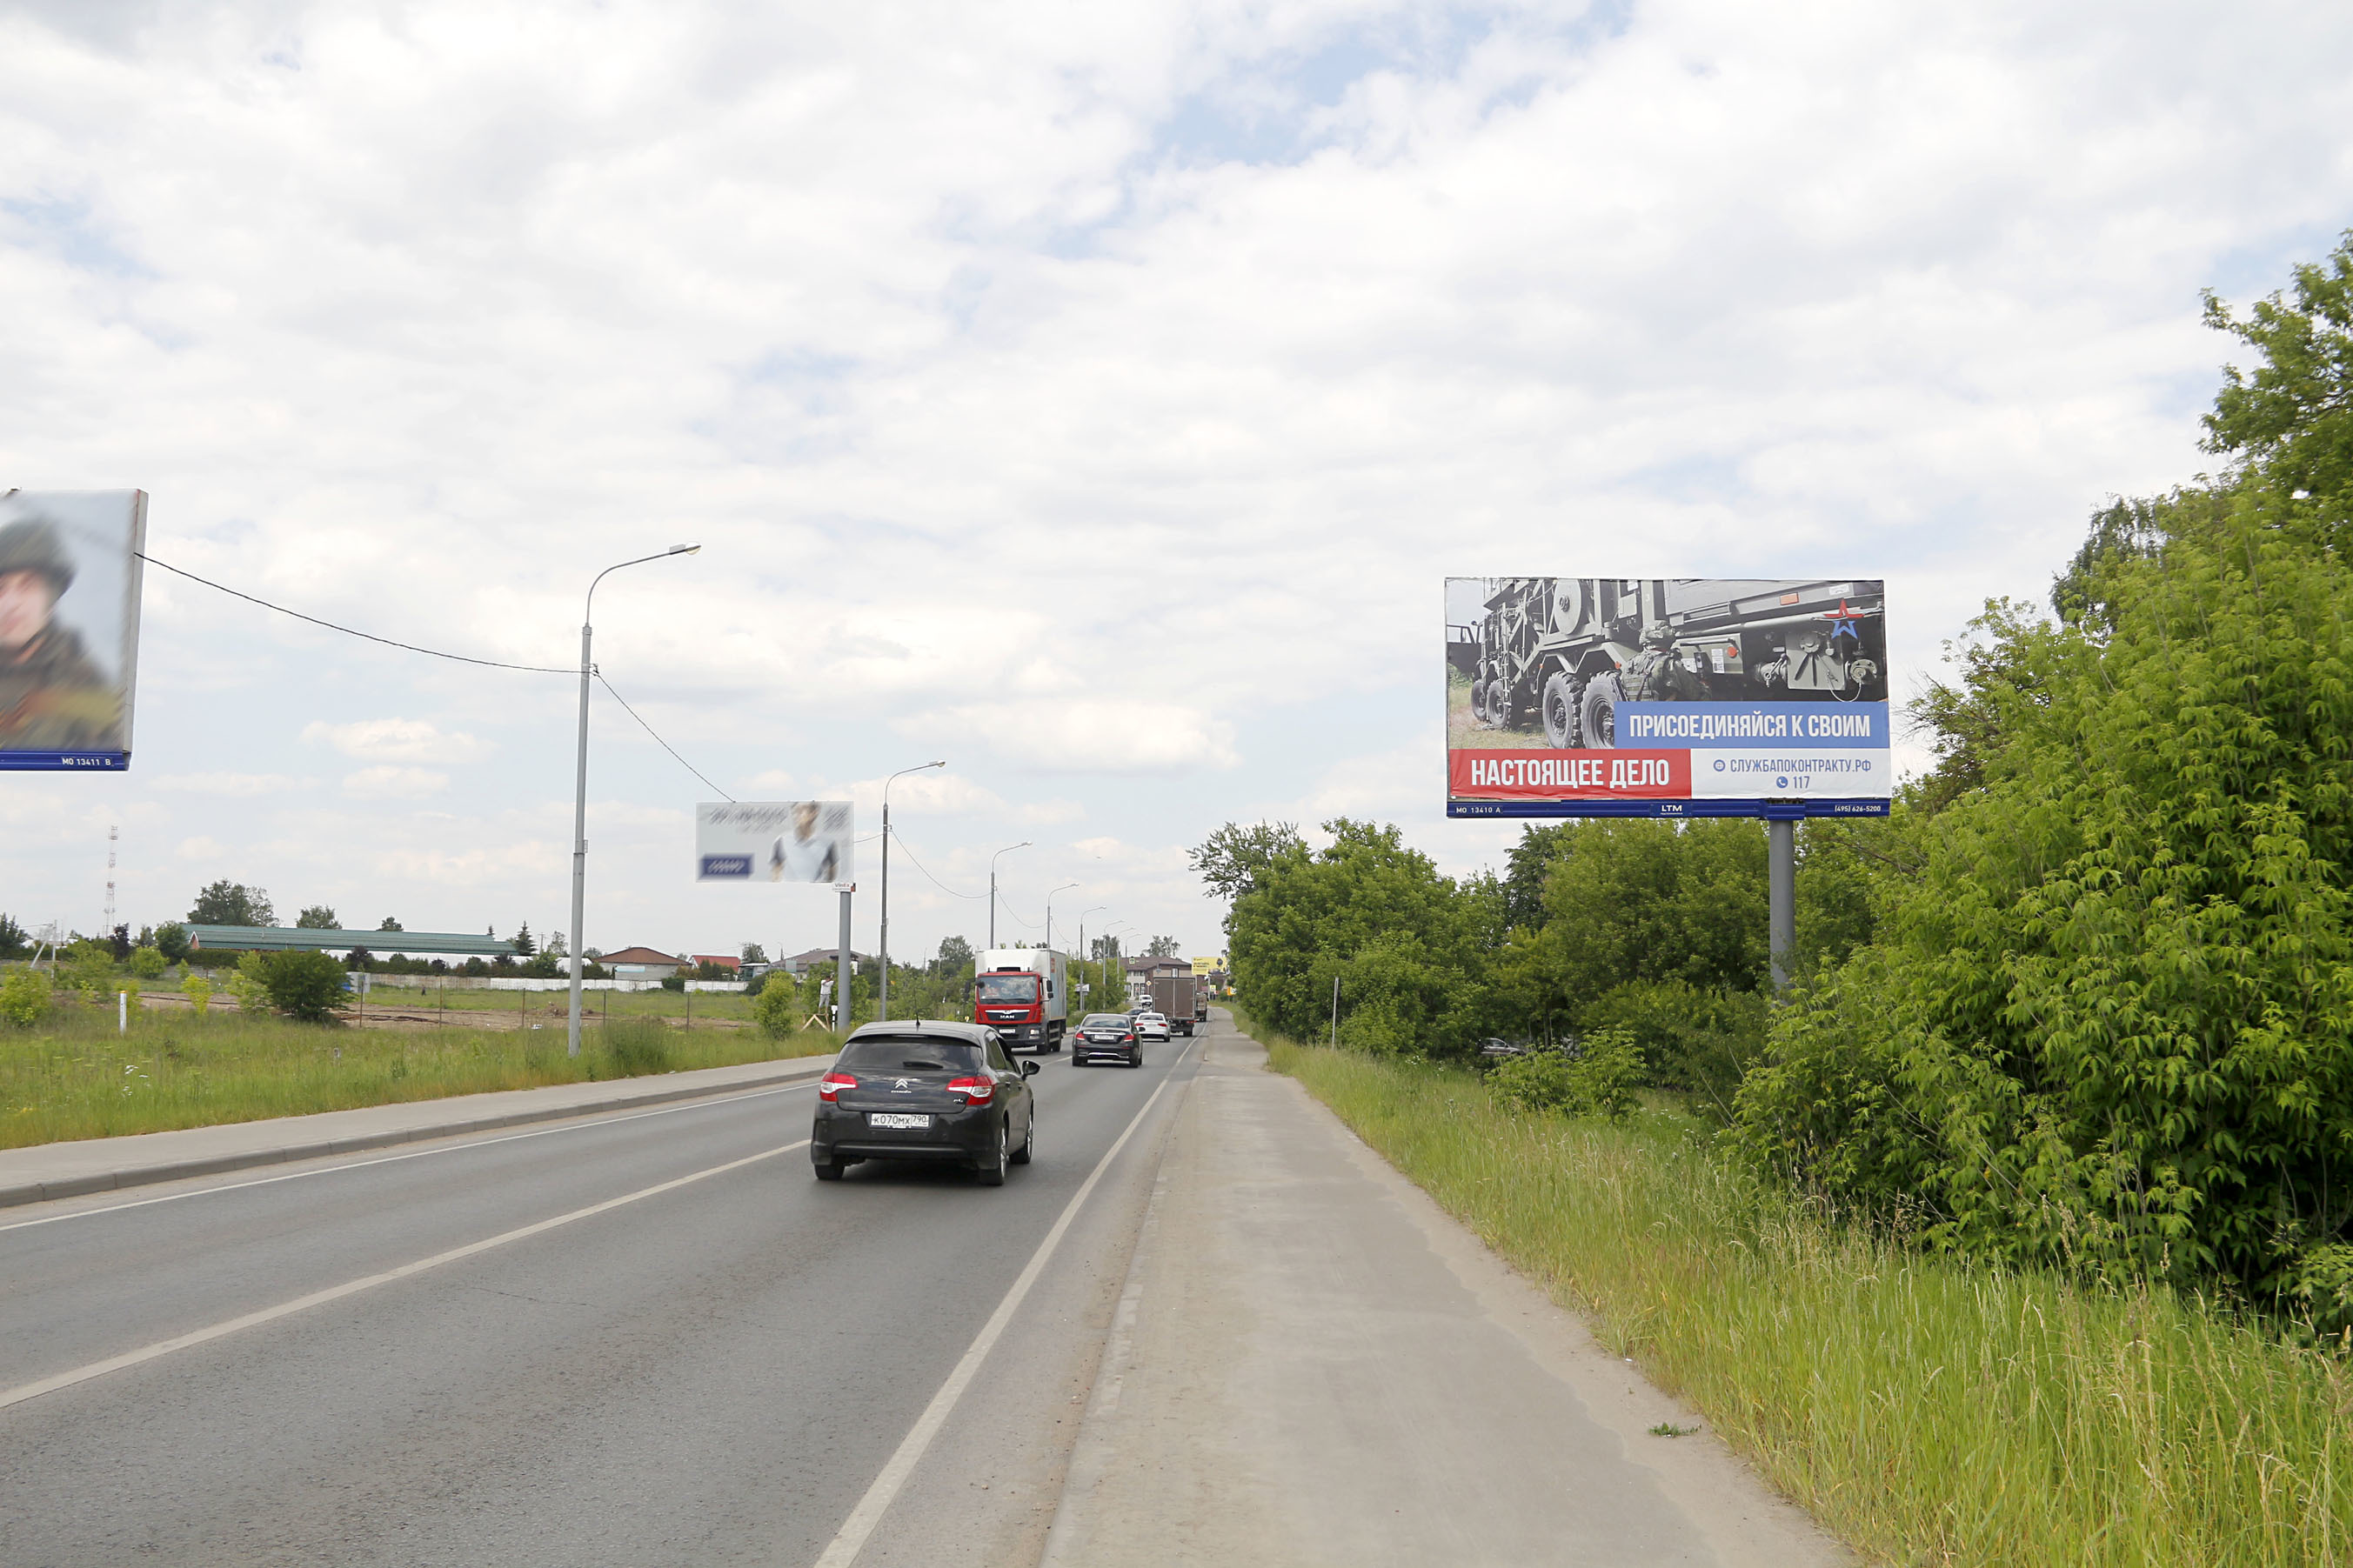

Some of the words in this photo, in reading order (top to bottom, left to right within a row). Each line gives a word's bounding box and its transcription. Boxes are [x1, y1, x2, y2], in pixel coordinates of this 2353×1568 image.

[1630, 711, 1786, 739] ПРИСОЕДИНЯЙСЯ
[1792, 715, 1803, 737] К
[1808, 715, 1870, 737] СВОИМ
[1471, 759, 1603, 789] НАСТОЯЩЕЕ
[1609, 759, 1670, 789] ДЕЛО
[1730, 759, 1871, 772] СЛУЖБАПОКОНТРАКТУ.РФ
[1794, 776, 1810, 789] 117
